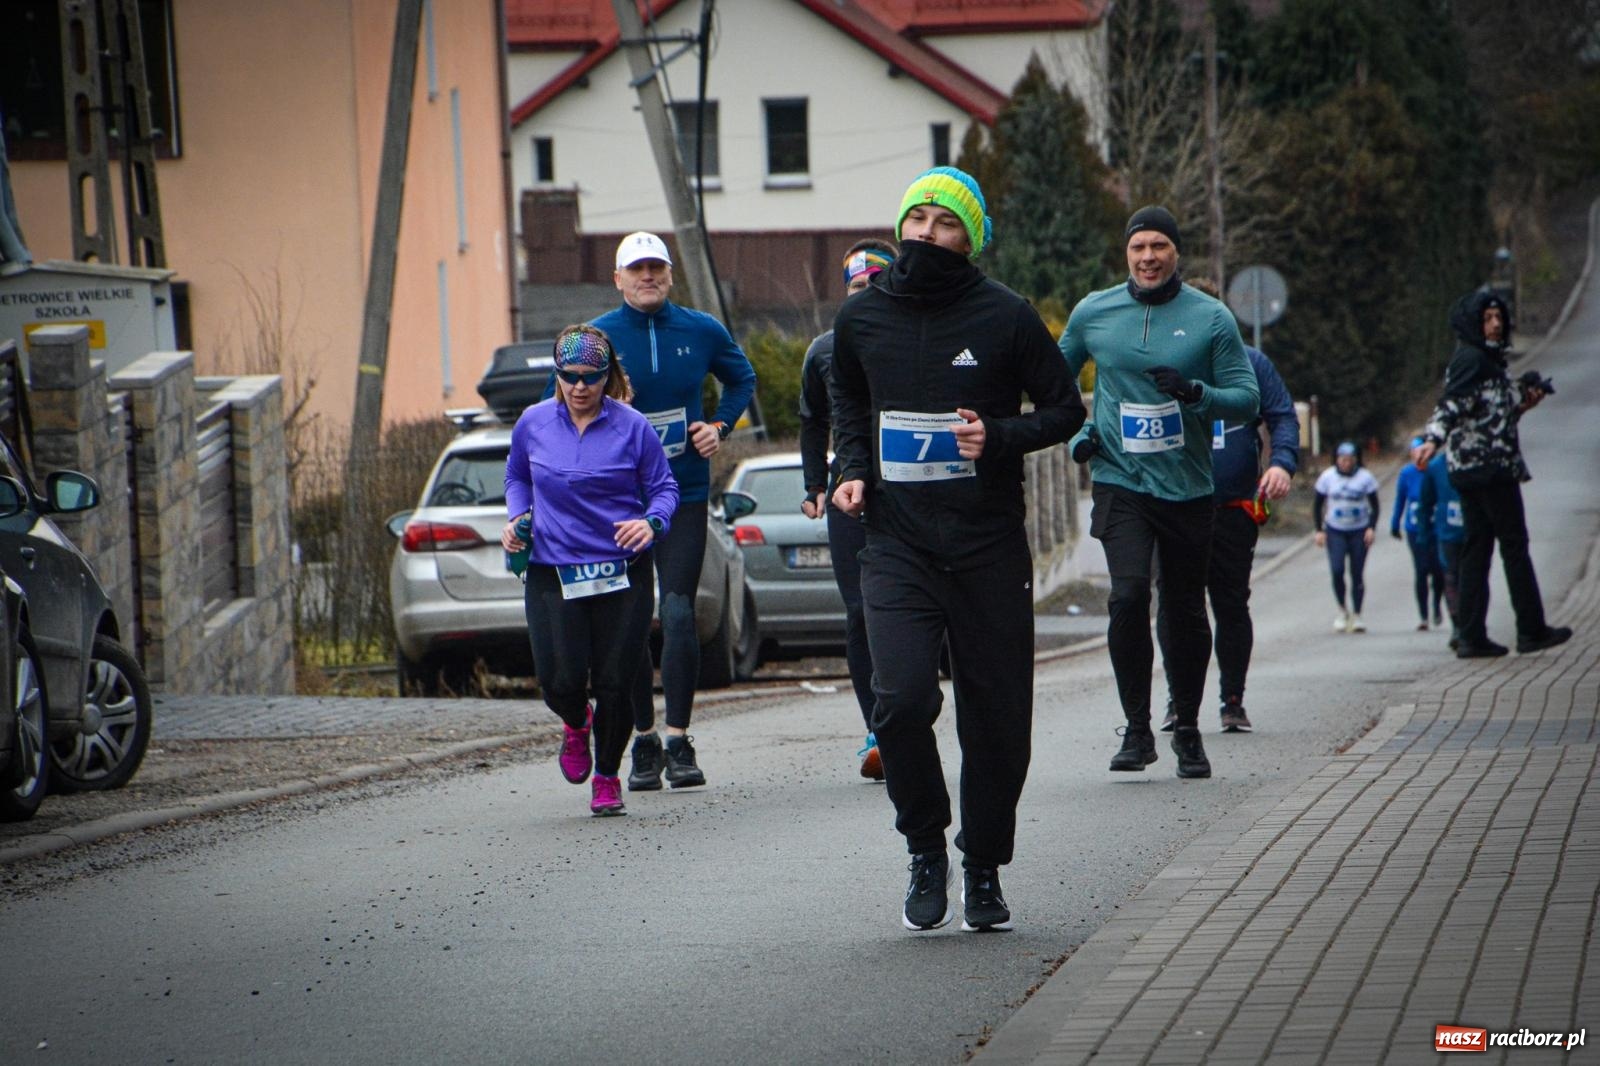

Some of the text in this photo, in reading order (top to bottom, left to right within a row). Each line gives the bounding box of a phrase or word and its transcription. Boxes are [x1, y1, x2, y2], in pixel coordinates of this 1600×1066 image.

[0, 288, 135, 305] ETROWICE WIELKIE
[35, 305, 91, 319] SZKOŁA
[952, 358, 978, 366] adidas
[656, 424, 669, 445] 7
[1136, 418, 1164, 438] 28
[913, 433, 933, 461] 7
